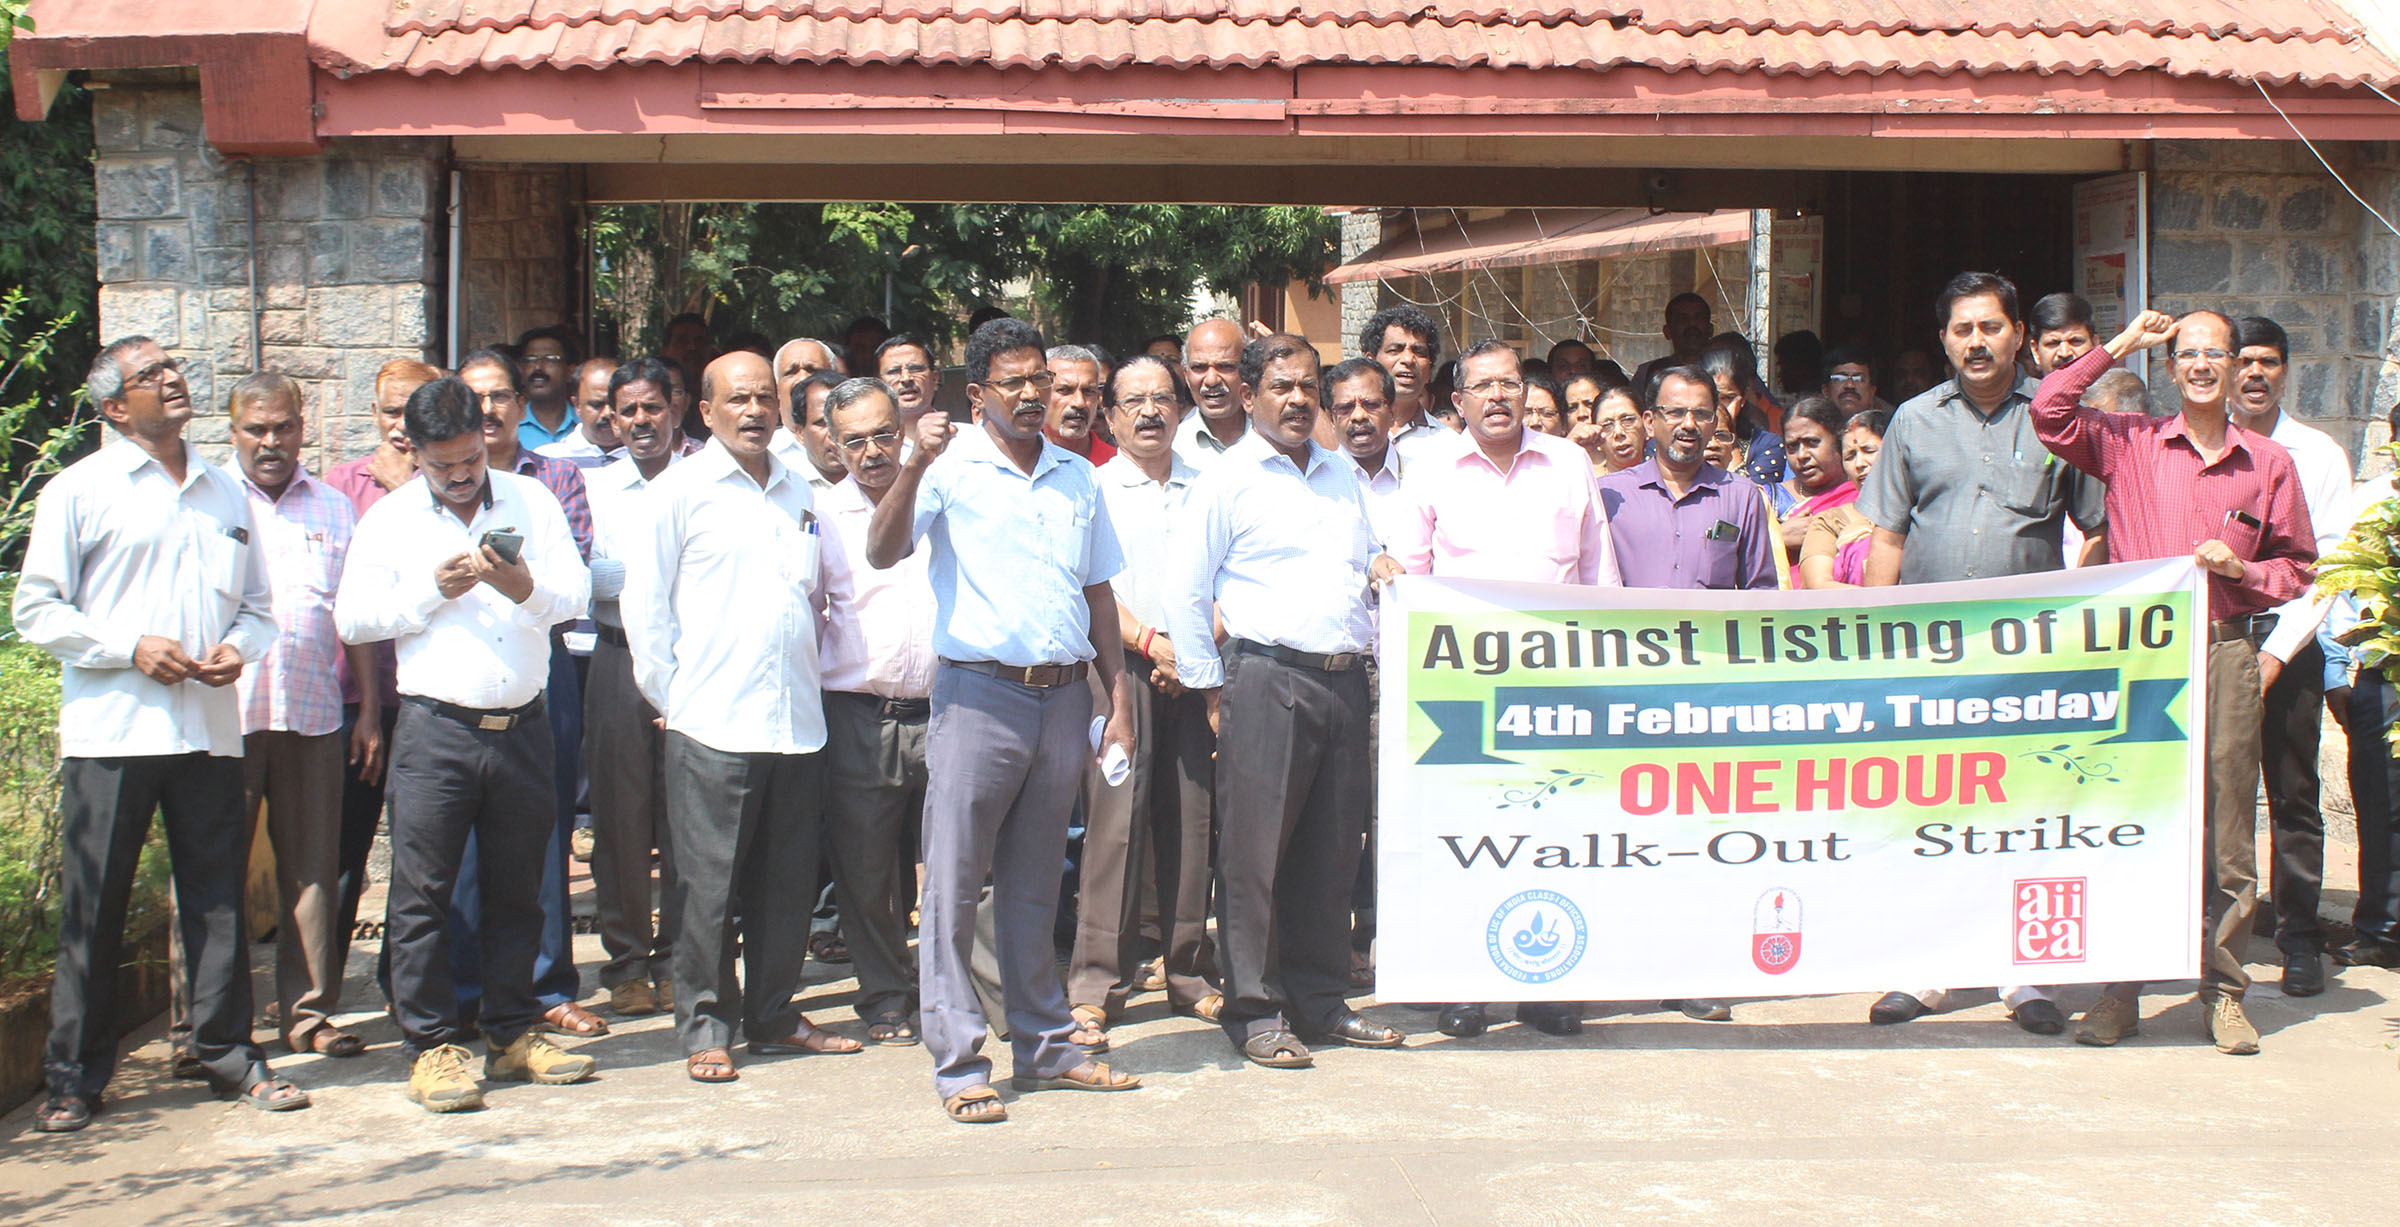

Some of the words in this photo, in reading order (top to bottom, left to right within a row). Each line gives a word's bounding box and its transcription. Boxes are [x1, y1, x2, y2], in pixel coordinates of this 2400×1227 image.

[1422, 621, 1702, 676] Against
[1726, 614, 1965, 664] Listing
[1990, 609, 2056, 655] of
[2082, 603, 2176, 653] LIC
[1496, 703, 1592, 736] 4th
[1607, 701, 1877, 736] February,
[1885, 688, 2120, 726] Tuesday
[1619, 761, 1781, 816] ONE
[1794, 752, 2008, 813] HOUR
[1438, 830, 1852, 870] Walk-Out
[1914, 815, 2146, 858] Strike
[1505, 894, 1527, 911] INDIA
[1489, 946, 1529, 981] FEDERATION
[1545, 935, 1585, 981] ASSOCIATIONS
